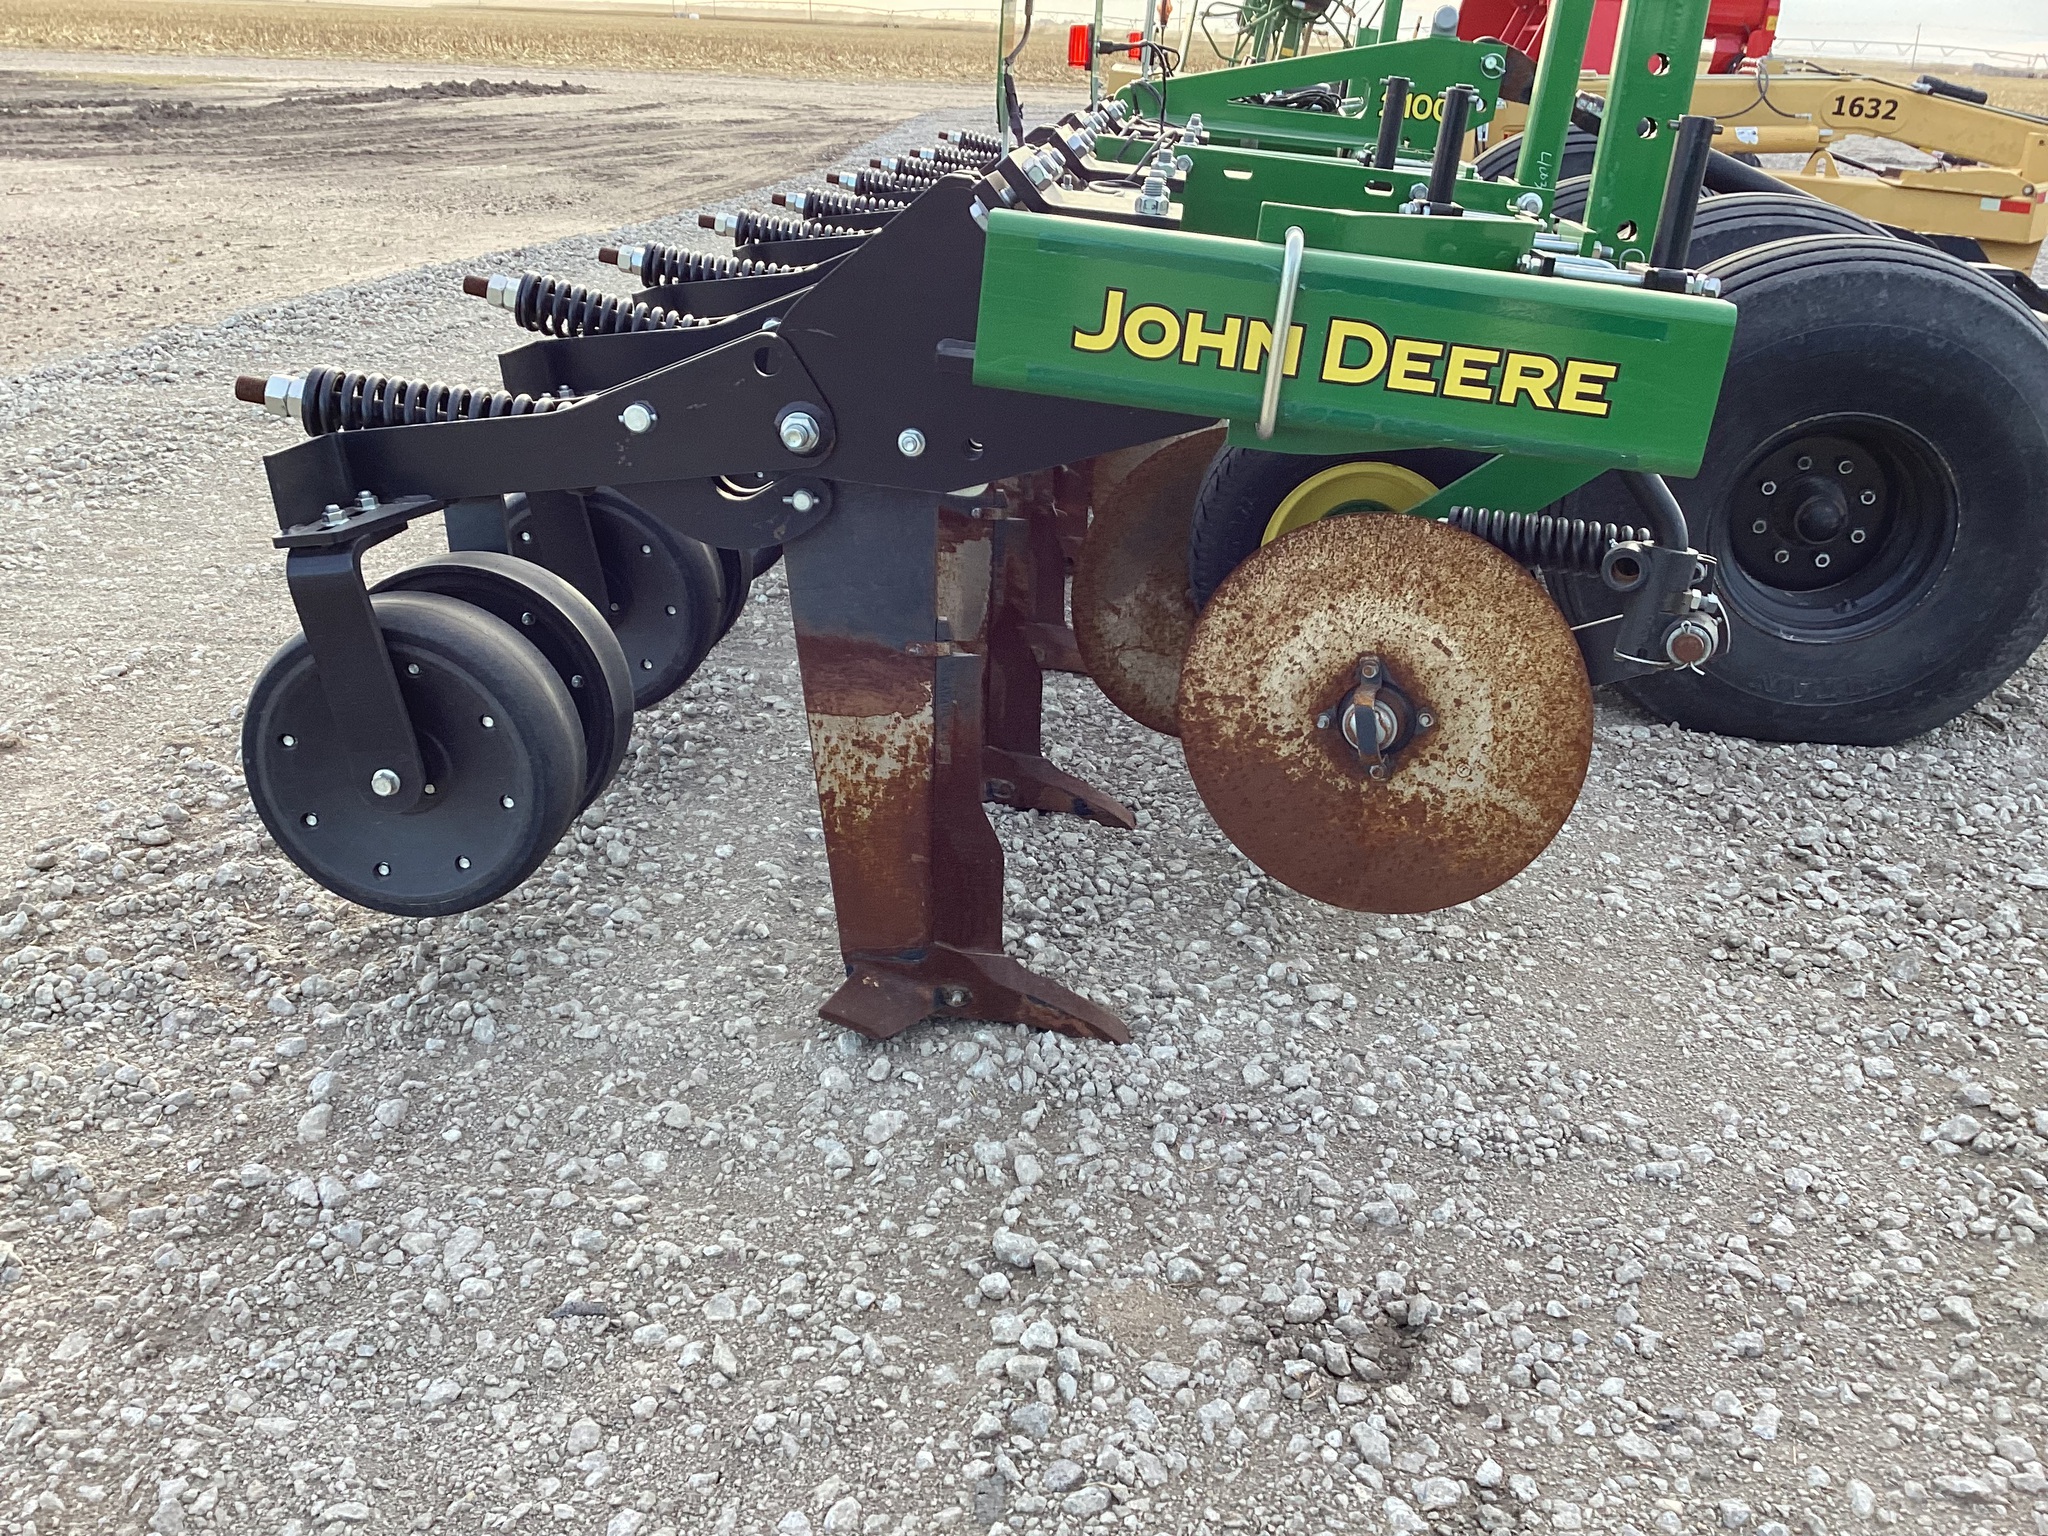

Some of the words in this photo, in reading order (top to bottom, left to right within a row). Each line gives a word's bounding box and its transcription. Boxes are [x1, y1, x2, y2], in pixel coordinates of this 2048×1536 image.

[1831, 94, 1899, 121] 1632
[1072, 287, 1307, 379] JOHN
[1319, 316, 1622, 418] DEERE
